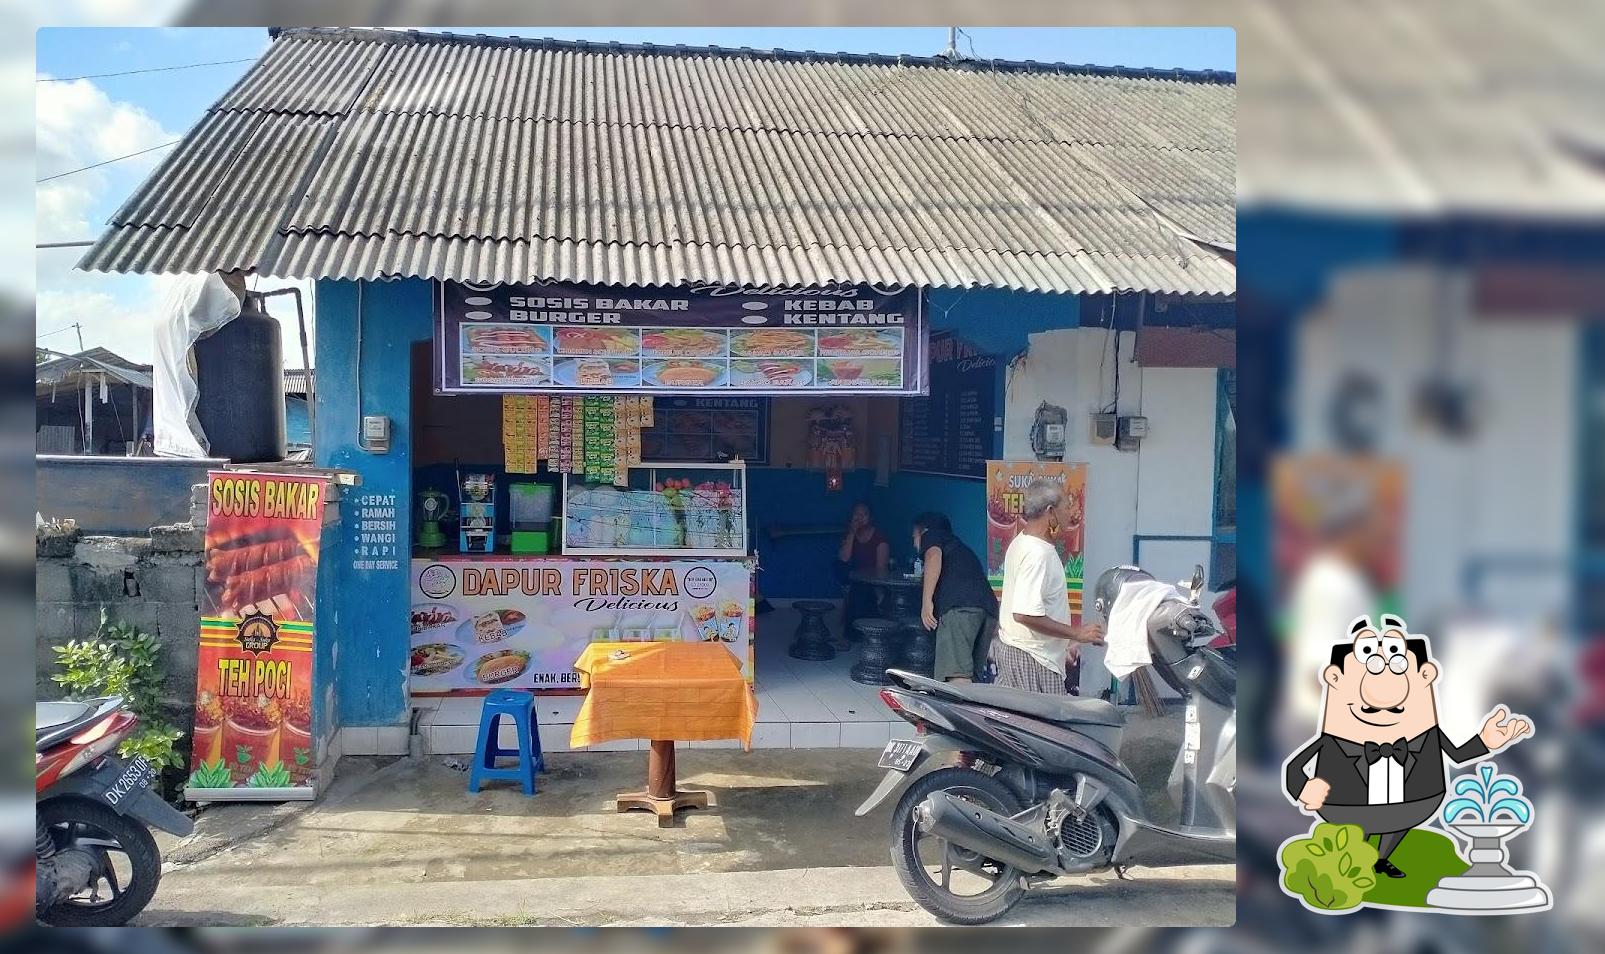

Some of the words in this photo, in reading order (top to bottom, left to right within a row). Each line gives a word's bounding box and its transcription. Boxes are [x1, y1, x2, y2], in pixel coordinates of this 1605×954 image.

[509, 296, 589, 308] SOSIS
[595, 299, 689, 311] BAKAR
[783, 300, 874, 311] KEBAB
[509, 311, 621, 324] BURGER
[783, 313, 905, 324] KENTANG
[695, 398, 759, 408] KENTANG
[212, 478, 261, 518] SOSIS
[263, 480, 319, 520] BAKAR
[361, 495, 396, 506] CEPAT
[361, 508, 395, 518] RAMAH
[361, 521, 396, 530] BERSIH
[361, 533, 396, 543] WANGI
[376, 560, 398, 569] SERVICE
[462, 568, 561, 596] DAPUR
[573, 596, 678, 612] Delicious
[218, 658, 251, 697] TEH
[253, 660, 292, 699] POCI
[105, 784, 126, 804] DK
[119, 765, 142, 791] 2653
